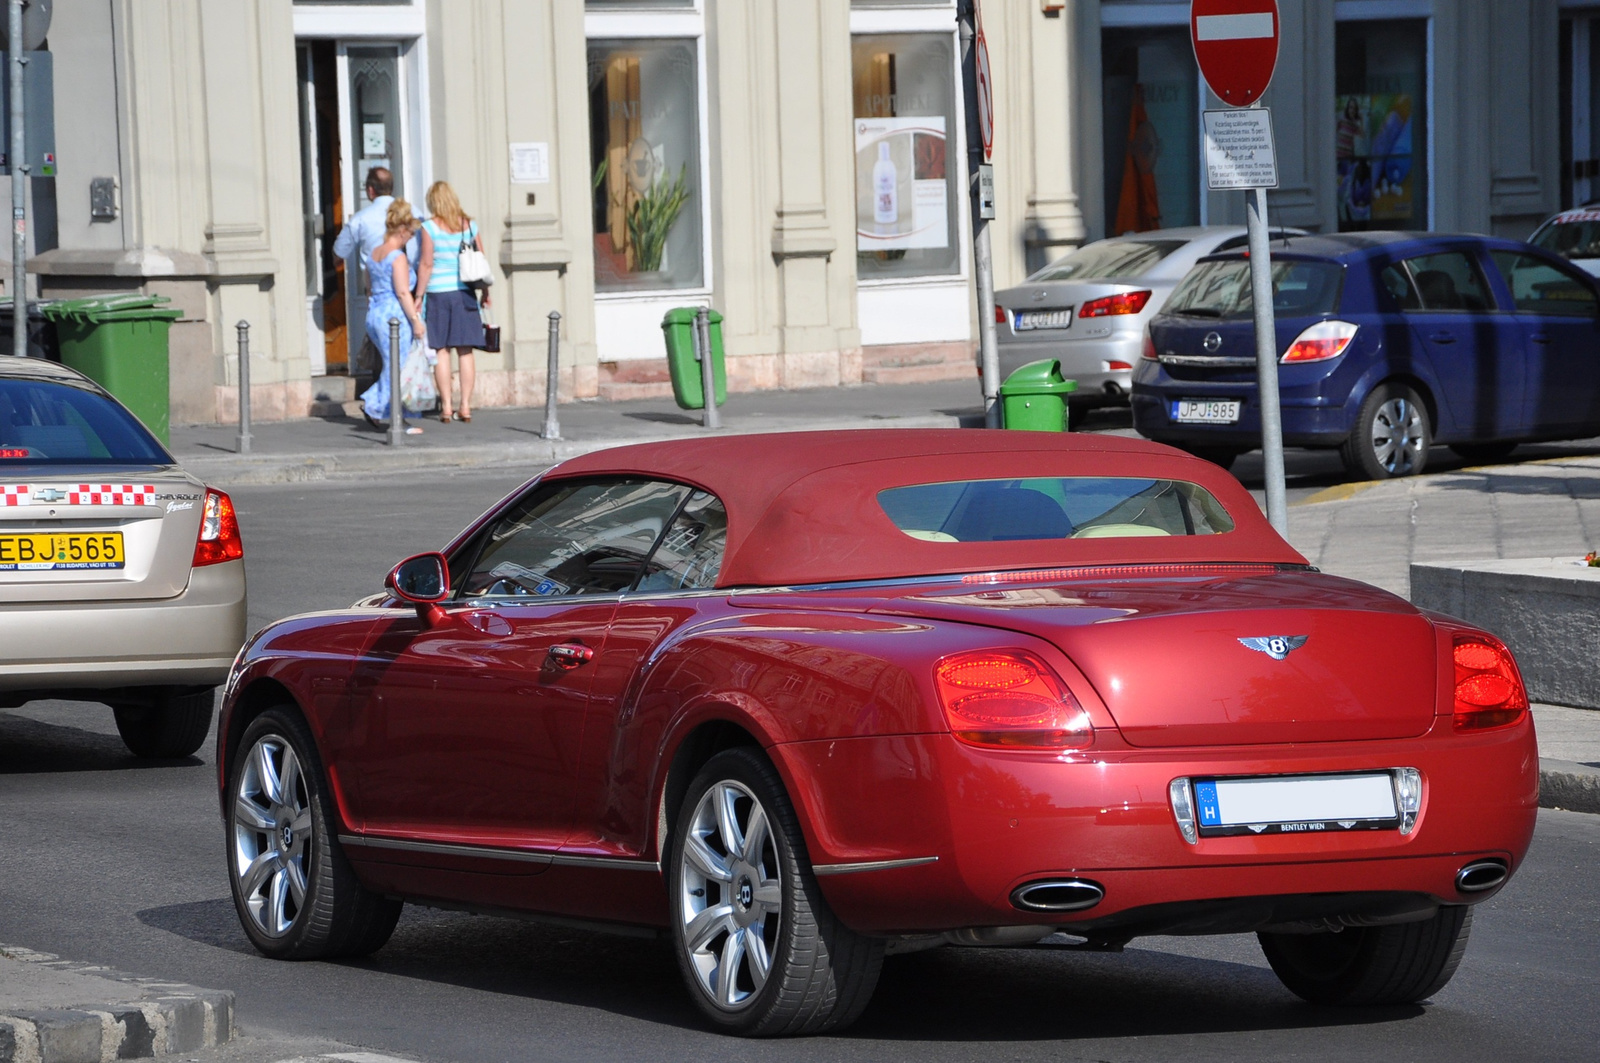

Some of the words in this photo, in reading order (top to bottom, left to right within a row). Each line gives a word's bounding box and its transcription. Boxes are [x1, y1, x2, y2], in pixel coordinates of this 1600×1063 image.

[155, 493, 203, 501] CHEVROLET
[1204, 806, 1216, 819] H
[1280, 823, 1308, 832] BENTLEY
[1308, 822, 1325, 830] WIEN
